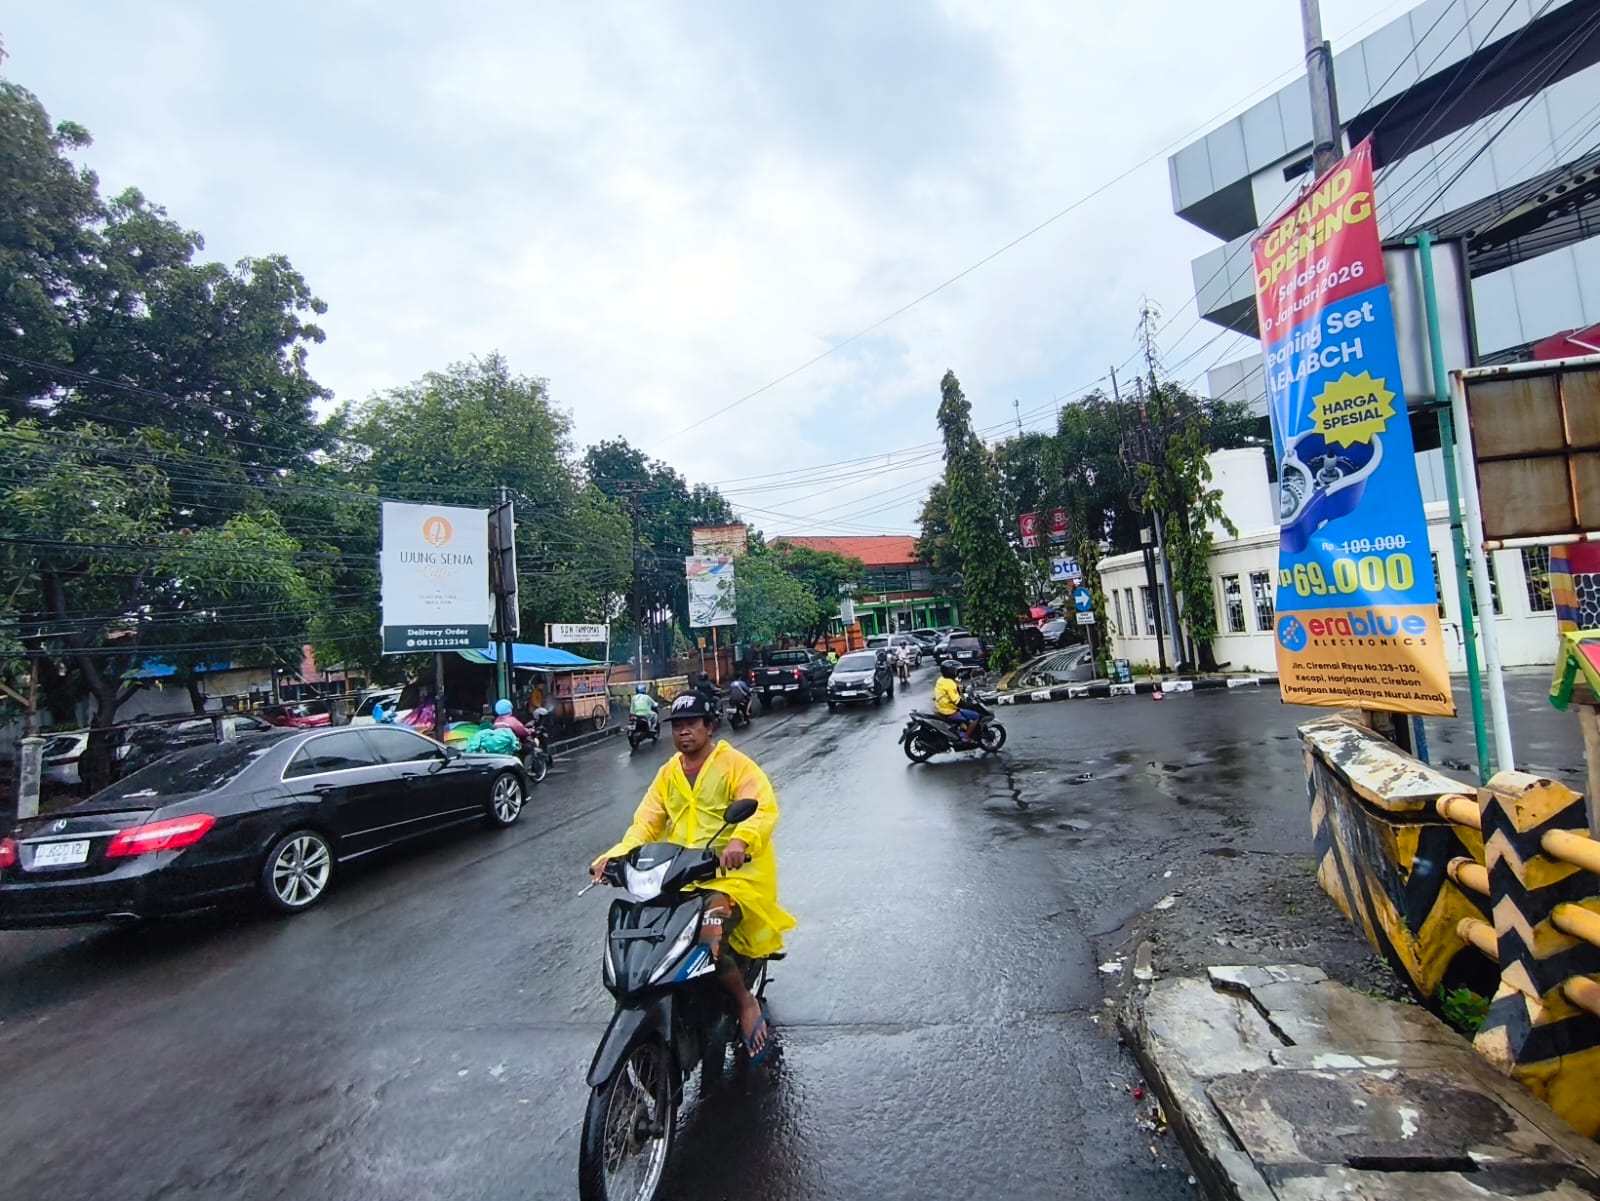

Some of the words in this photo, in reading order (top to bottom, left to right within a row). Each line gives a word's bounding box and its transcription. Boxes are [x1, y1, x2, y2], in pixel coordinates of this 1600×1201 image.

[1264, 168, 1353, 259] GRAND
[1257, 191, 1373, 294] OPENING
[1319, 261, 1364, 296] 2026
[1326, 301, 1375, 335] Set
[1323, 392, 1378, 415] HARGA
[1323, 406, 1384, 430] SPESIAL
[1341, 534, 1406, 554] 109.000
[400, 552, 436, 564] UJUNG
[440, 553, 473, 565] SENJA
[407, 629, 442, 637] Delivery
[445, 628, 469, 636] Order
[1308, 611, 1427, 637] erablue
[1314, 639, 1427, 647] ELECTRONICS
[1306, 661, 1340, 671] Ciremai
[1328, 674, 1380, 685] Harjamukti,
[1381, 677, 1422, 688] Cirebon
[1329, 686, 1359, 697] Masjid
[1359, 687, 1383, 699] Raya
[1384, 690, 1412, 701] Nurul
